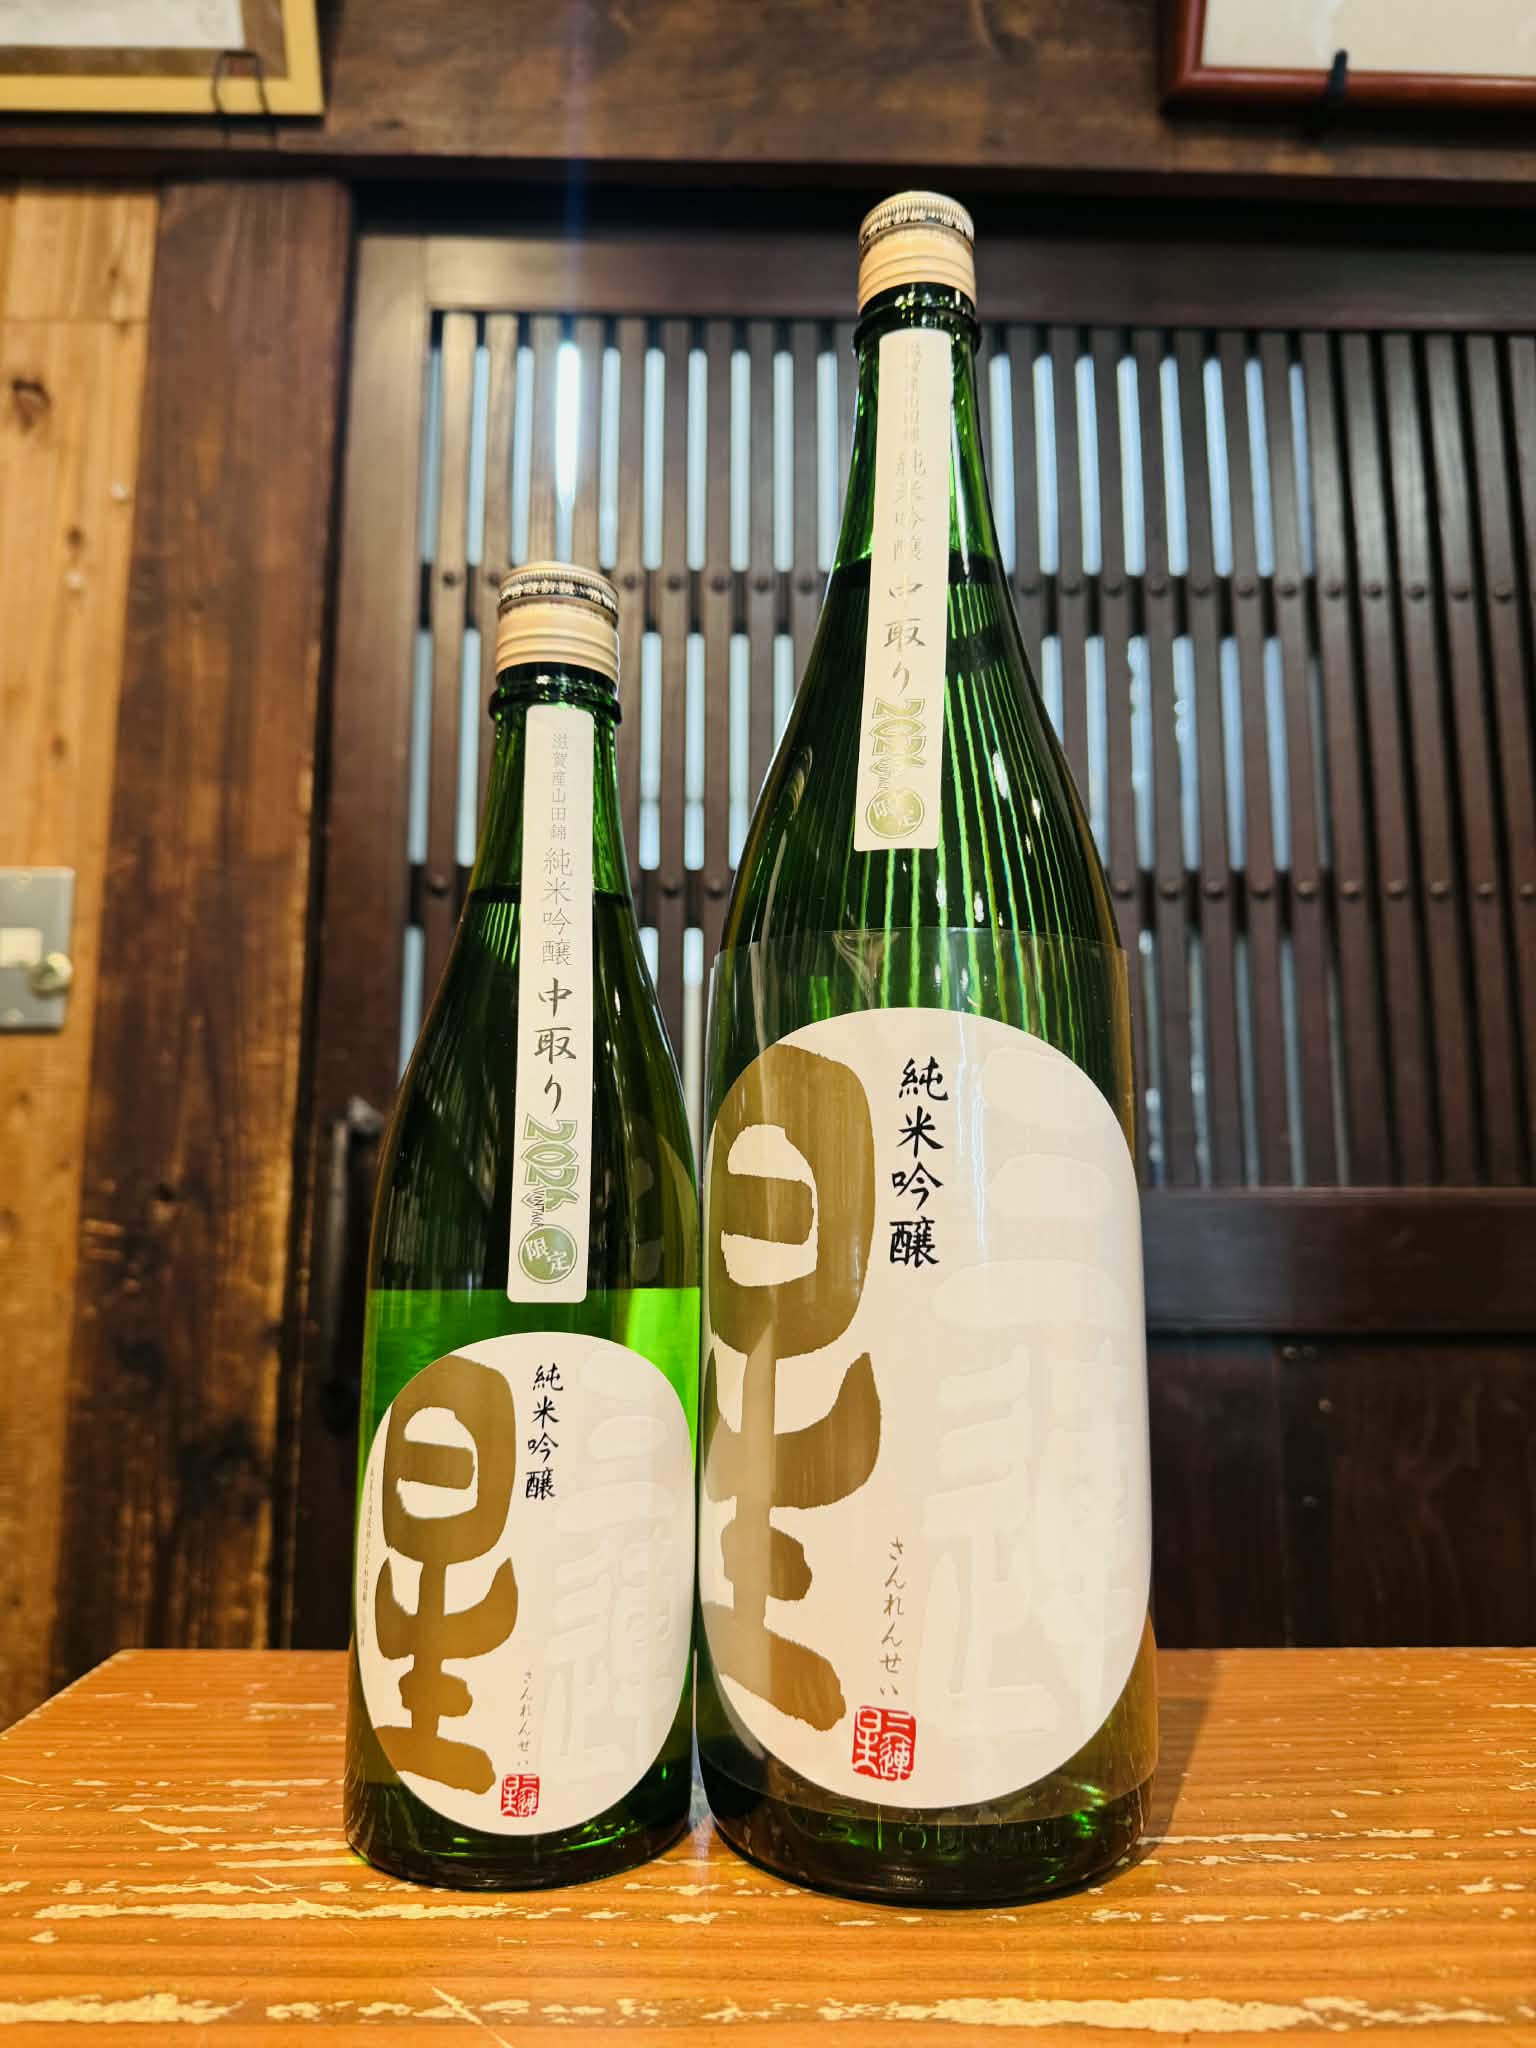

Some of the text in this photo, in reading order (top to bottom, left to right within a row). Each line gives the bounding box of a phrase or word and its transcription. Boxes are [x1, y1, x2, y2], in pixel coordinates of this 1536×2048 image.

[882, 576, 927, 696] 中取り
[550, 732, 569, 841] 滋賀産山田錦
[541, 846, 574, 967] 純米吟醸
[531, 976, 577, 1114] 中取り
[889, 1056, 949, 1266] 純米吟醸
[524, 1236, 571, 1275] 限定
[525, 1362, 565, 1501] 純米吟醸
[879, 1535, 907, 1697] さんれんせい
